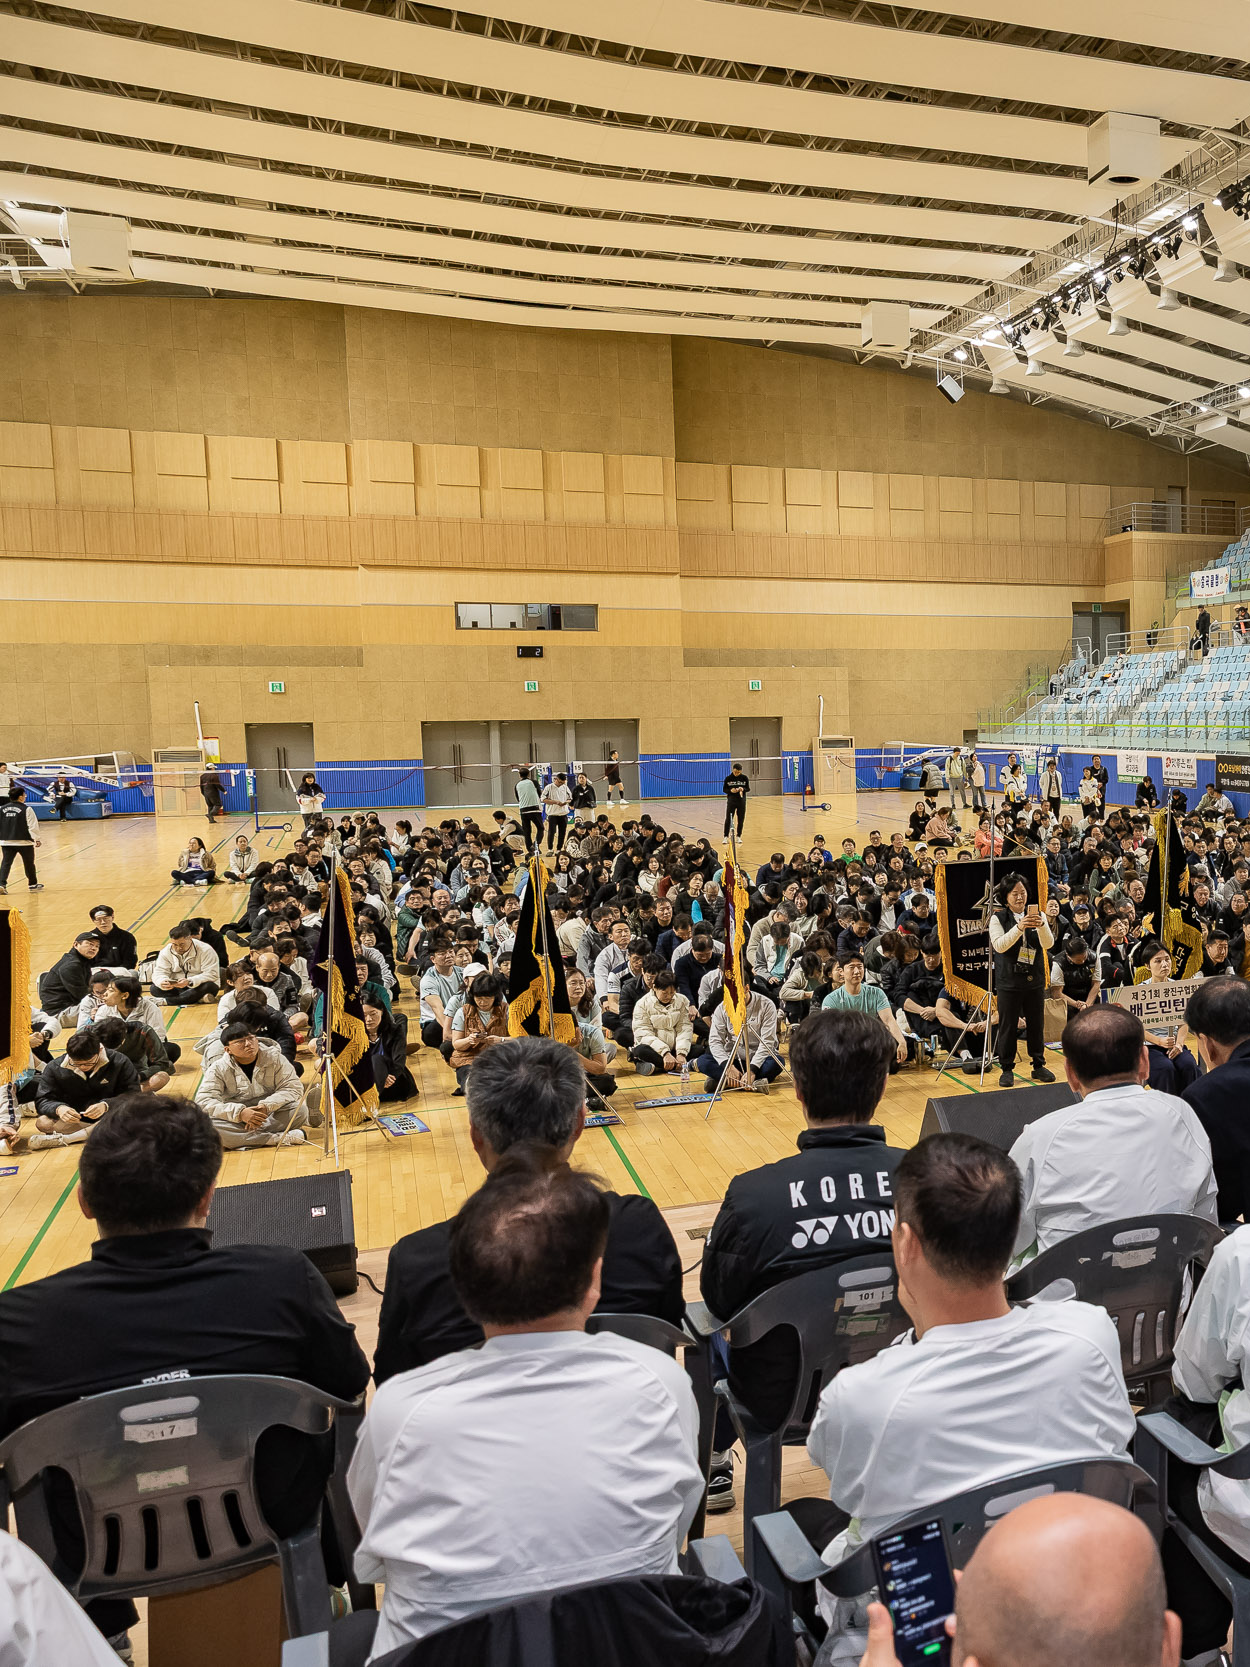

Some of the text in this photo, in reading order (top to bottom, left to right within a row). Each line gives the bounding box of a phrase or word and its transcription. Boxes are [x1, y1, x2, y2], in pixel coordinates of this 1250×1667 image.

[1132, 989, 1160, 1000] 제31회
[789, 1171, 893, 1208] KORE
[844, 1209, 896, 1239] YON
[859, 1292, 874, 1301] 101
